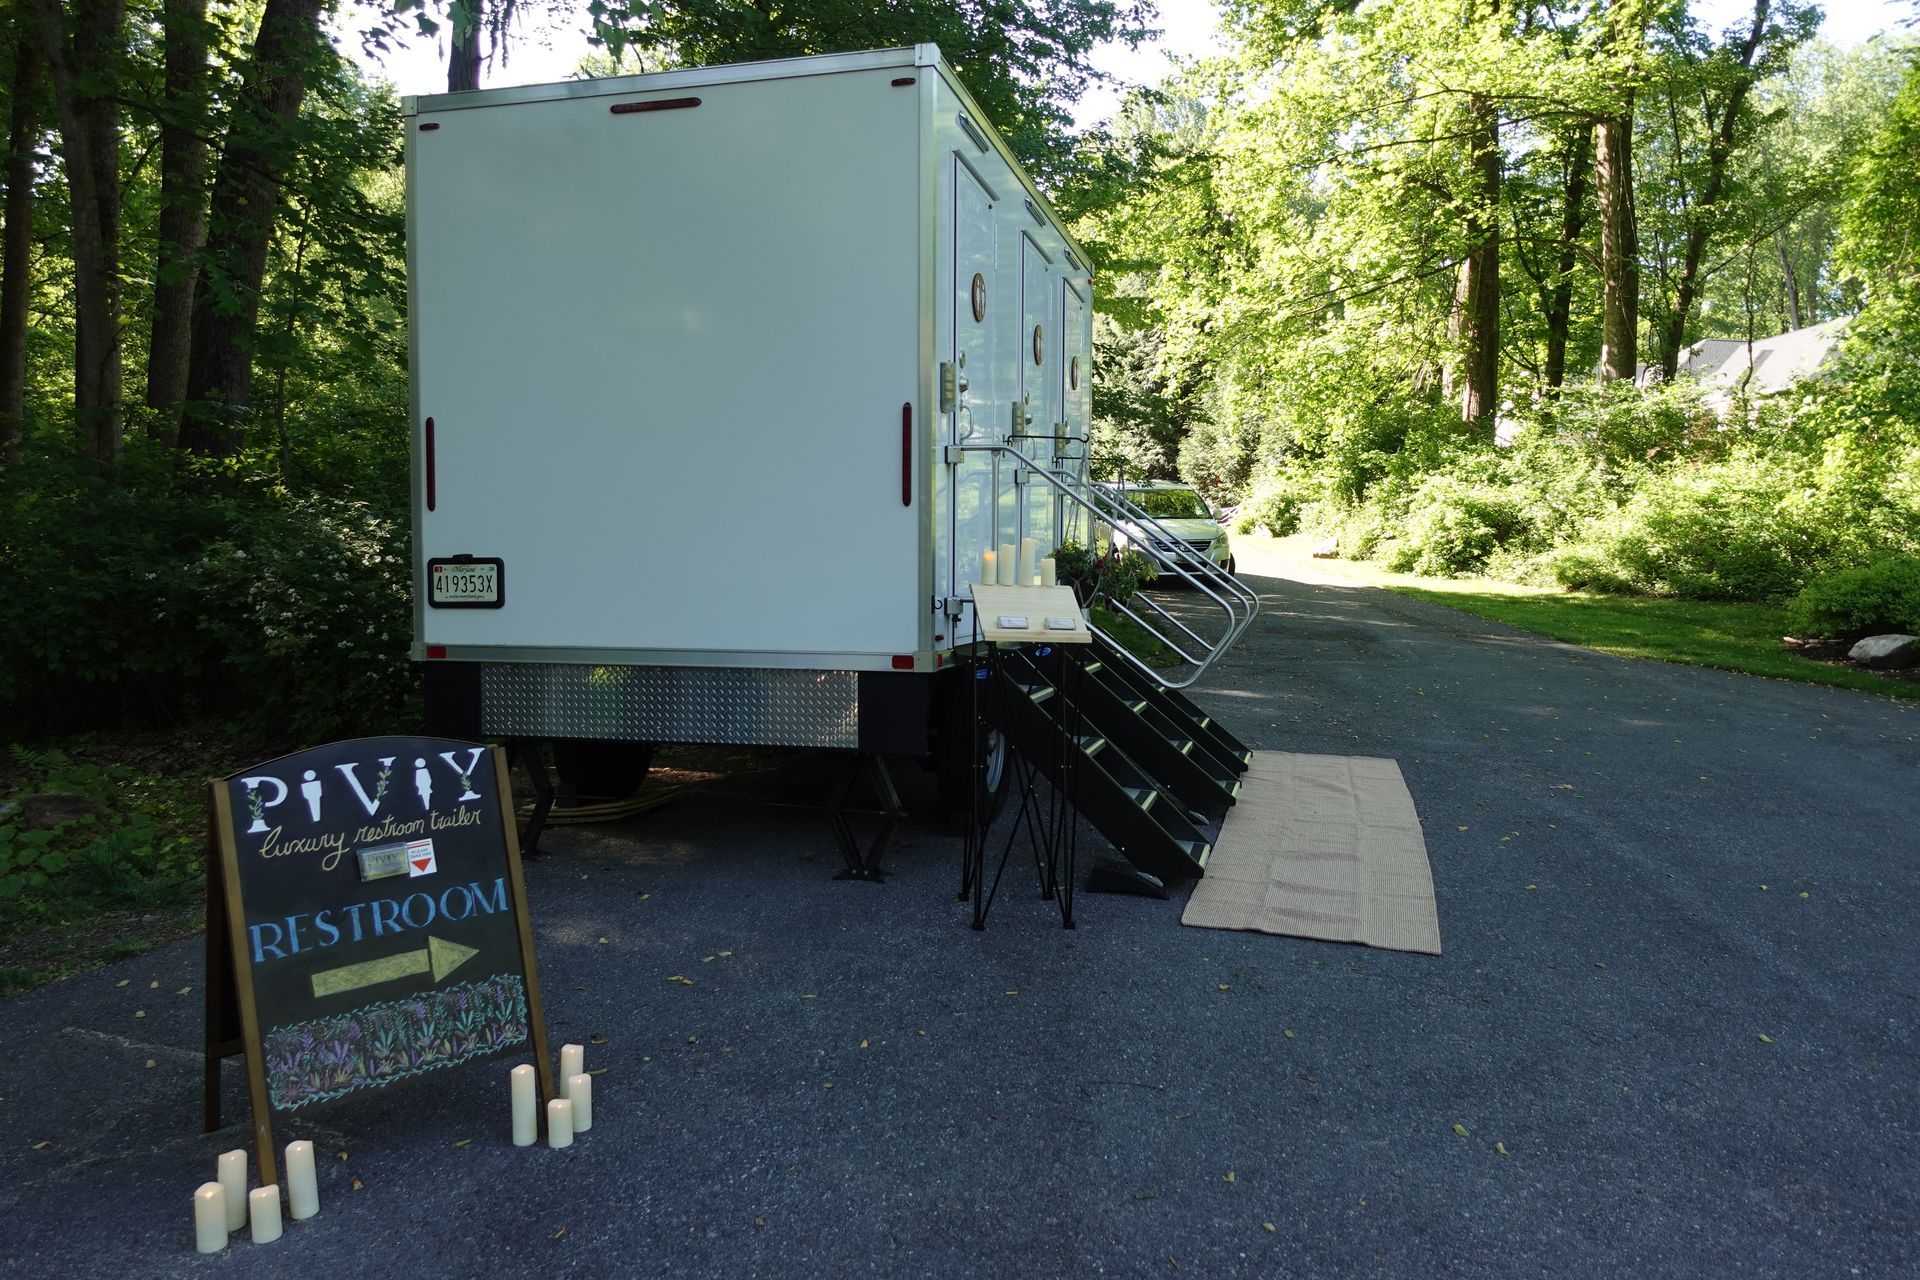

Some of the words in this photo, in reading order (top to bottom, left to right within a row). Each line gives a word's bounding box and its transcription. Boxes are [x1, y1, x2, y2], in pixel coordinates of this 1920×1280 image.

[436, 574, 493, 593] 419353X
[259, 825, 350, 871] luxury
[353, 815, 424, 843] restroom
[430, 804, 482, 830] trailer
[249, 877, 510, 964] RESTROOM
